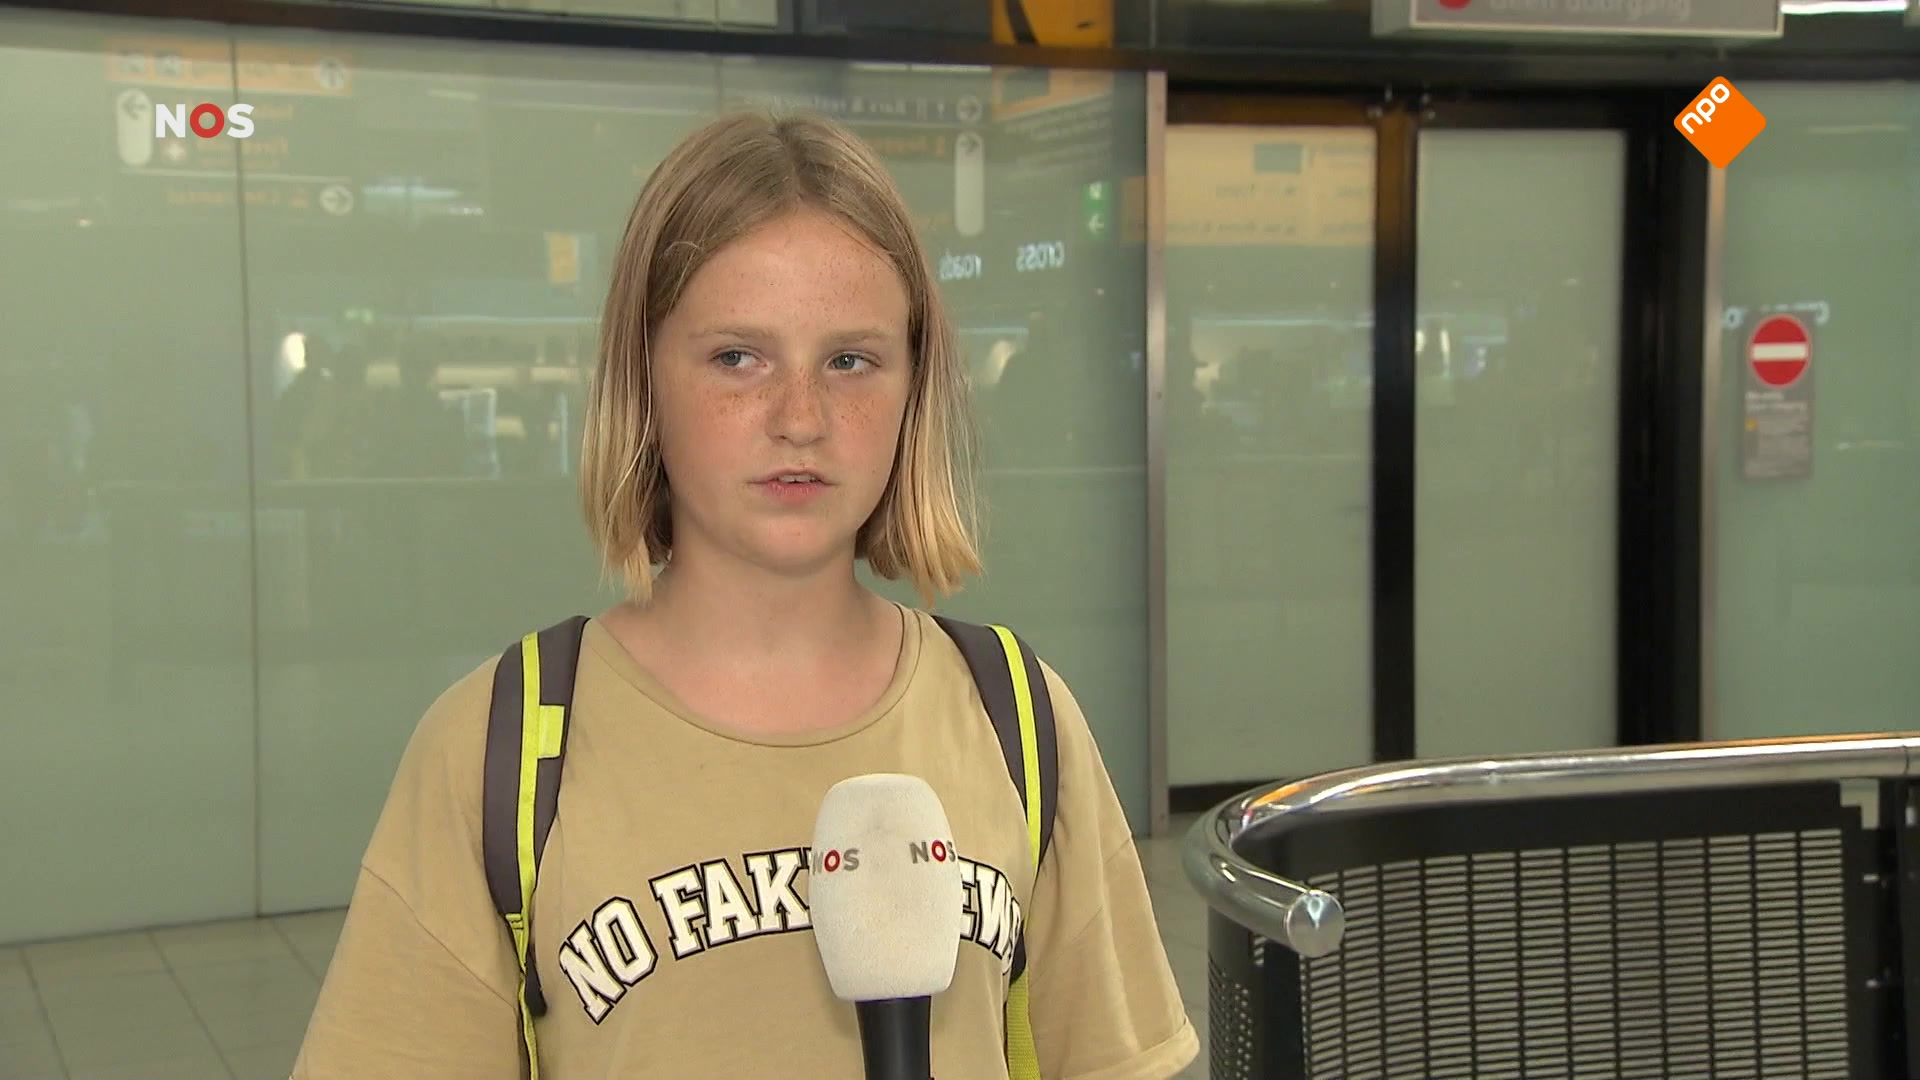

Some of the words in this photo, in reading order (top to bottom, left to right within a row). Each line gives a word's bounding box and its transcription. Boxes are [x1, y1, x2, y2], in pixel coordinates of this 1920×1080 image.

[909, 839, 956, 864] NOS
[559, 896, 658, 1025] NO
[649, 846, 814, 960] FAK
